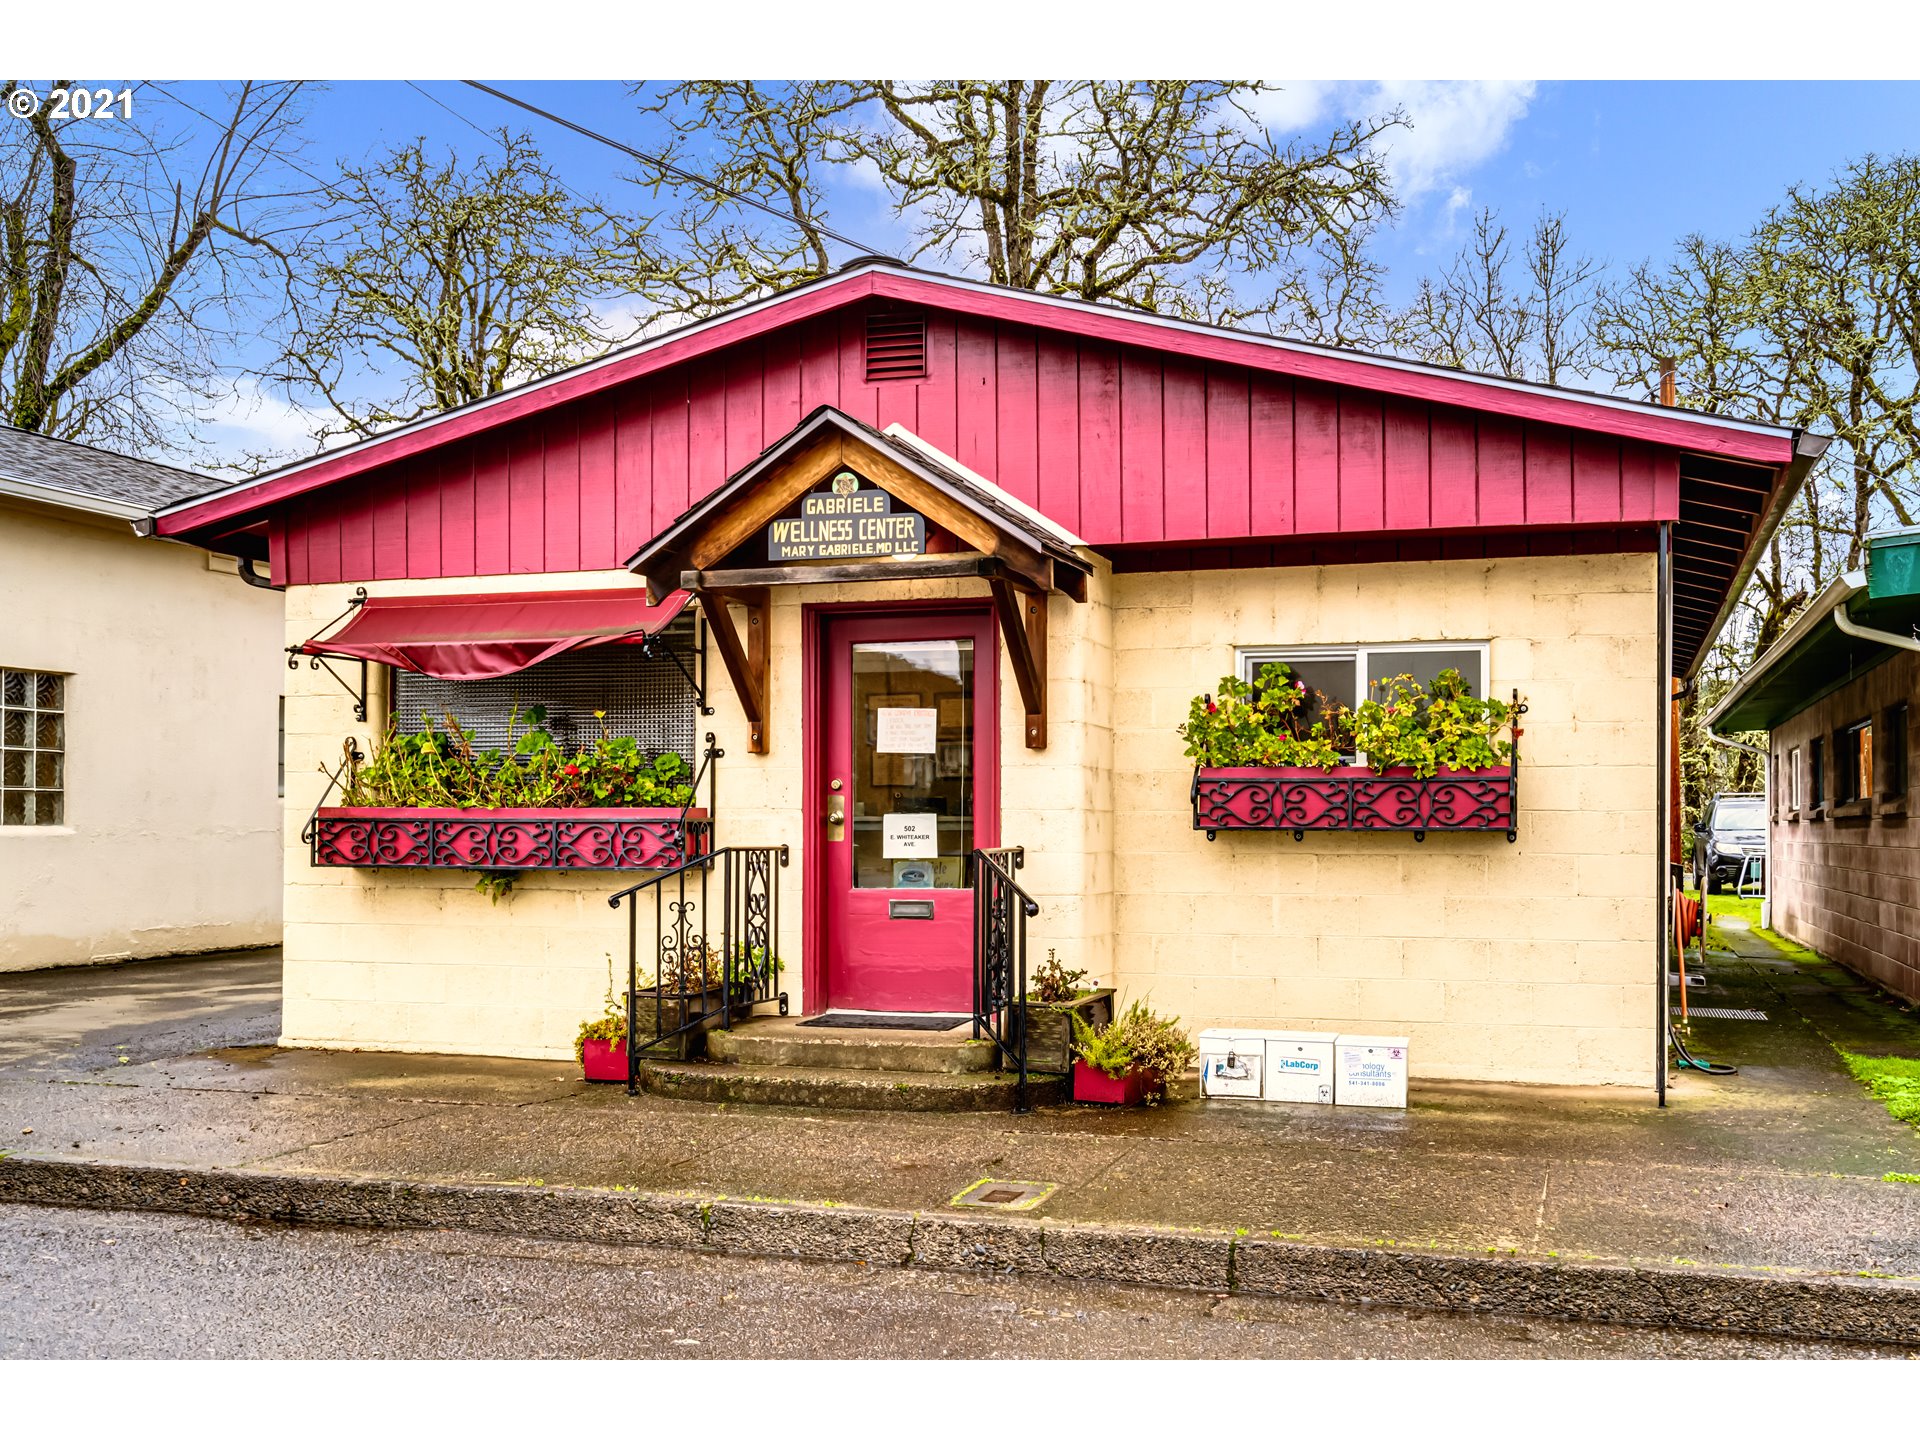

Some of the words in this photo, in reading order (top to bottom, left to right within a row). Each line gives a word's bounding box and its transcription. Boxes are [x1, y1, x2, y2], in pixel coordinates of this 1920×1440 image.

[806, 496, 884, 515] GABRIELE
[773, 519, 853, 543] WELLNESS
[858, 516, 915, 541] CENTER
[781, 545, 815, 558] MARY
[895, 541, 919, 553] LLC
[1285, 1059, 1319, 1071] LabCorp
